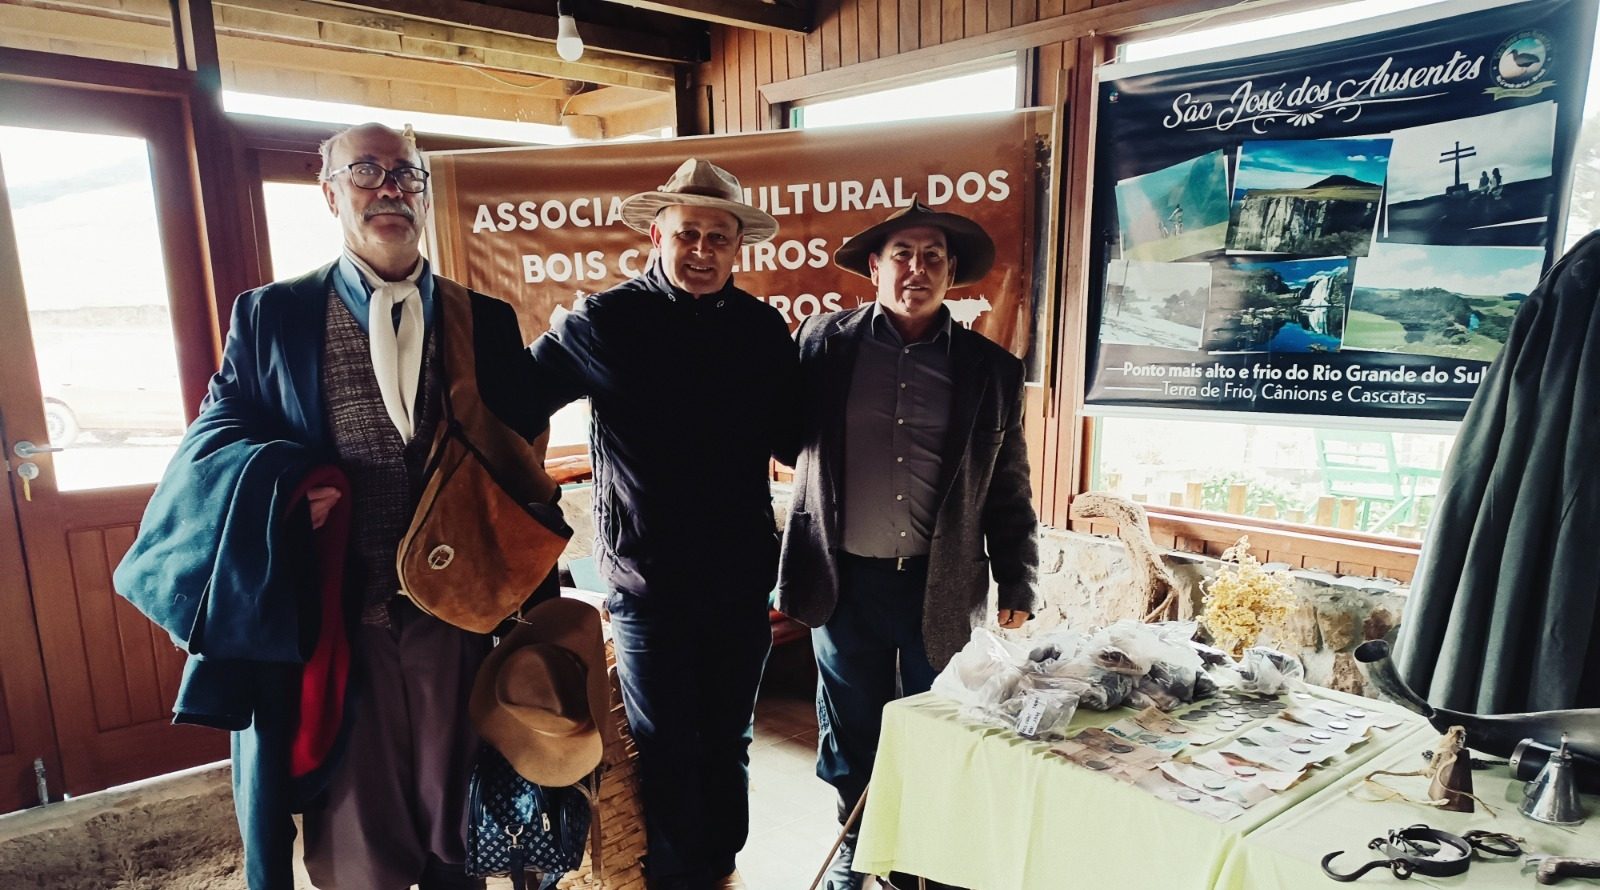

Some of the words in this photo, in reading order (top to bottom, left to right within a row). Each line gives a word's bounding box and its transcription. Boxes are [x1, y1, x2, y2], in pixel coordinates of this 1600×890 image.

[1163, 93, 1212, 128] São
[1216, 81, 1287, 131] José
[1287, 76, 1332, 107] dos
[1337, 50, 1485, 101] Ausentes
[473, 196, 624, 234] ASSOCIA
[743, 177, 915, 215] ULTURAL
[927, 169, 1010, 206] DOS
[522, 250, 607, 283] BOIS
[1123, 361, 1165, 377] Ponto
[1169, 363, 1202, 378] mais
[1205, 363, 1236, 379] alto
[1238, 367, 1249, 379] e
[1253, 363, 1282, 380] frio
[1285, 364, 1309, 381] do
[1313, 364, 1342, 381] Rio
[1346, 365, 1417, 383] Grande
[1421, 365, 1449, 384] do
[1453, 365, 1487, 384] Sul
[1162, 380, 1197, 397] Terra
[1200, 382, 1220, 397] de
[1224, 382, 1257, 402] Frio,
[1261, 383, 1327, 402] Cânions
[1331, 389, 1343, 402] e
[1348, 385, 1426, 405] Cascatas
